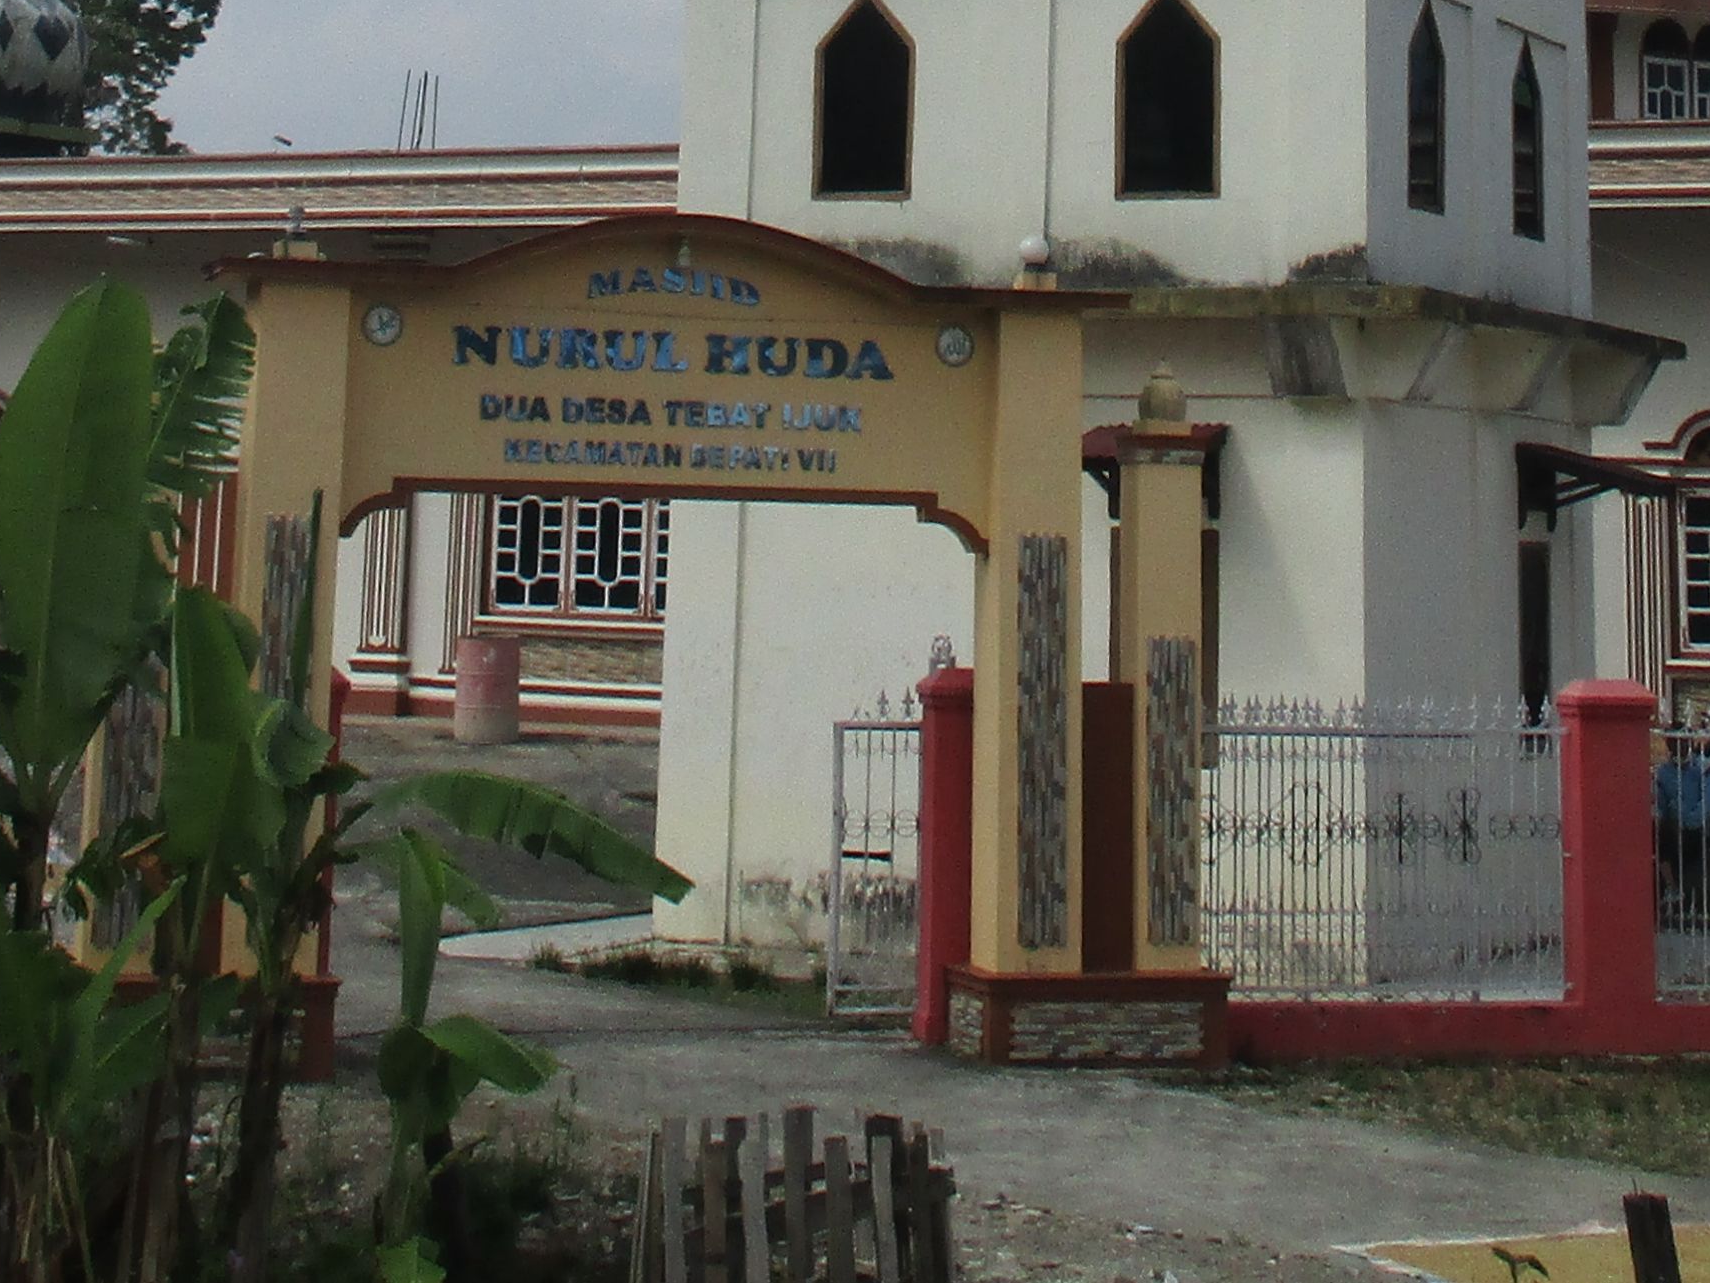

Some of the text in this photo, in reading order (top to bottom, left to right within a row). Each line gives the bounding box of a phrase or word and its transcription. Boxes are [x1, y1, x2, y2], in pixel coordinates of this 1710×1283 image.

[588, 267, 760, 306] MASJID
[452, 324, 894, 380] NURUL HUDA
[480, 394, 862, 432] DUA DESA TEBAT IJUK
[504, 438, 837, 473] KECAMATAN DEPATI VII
